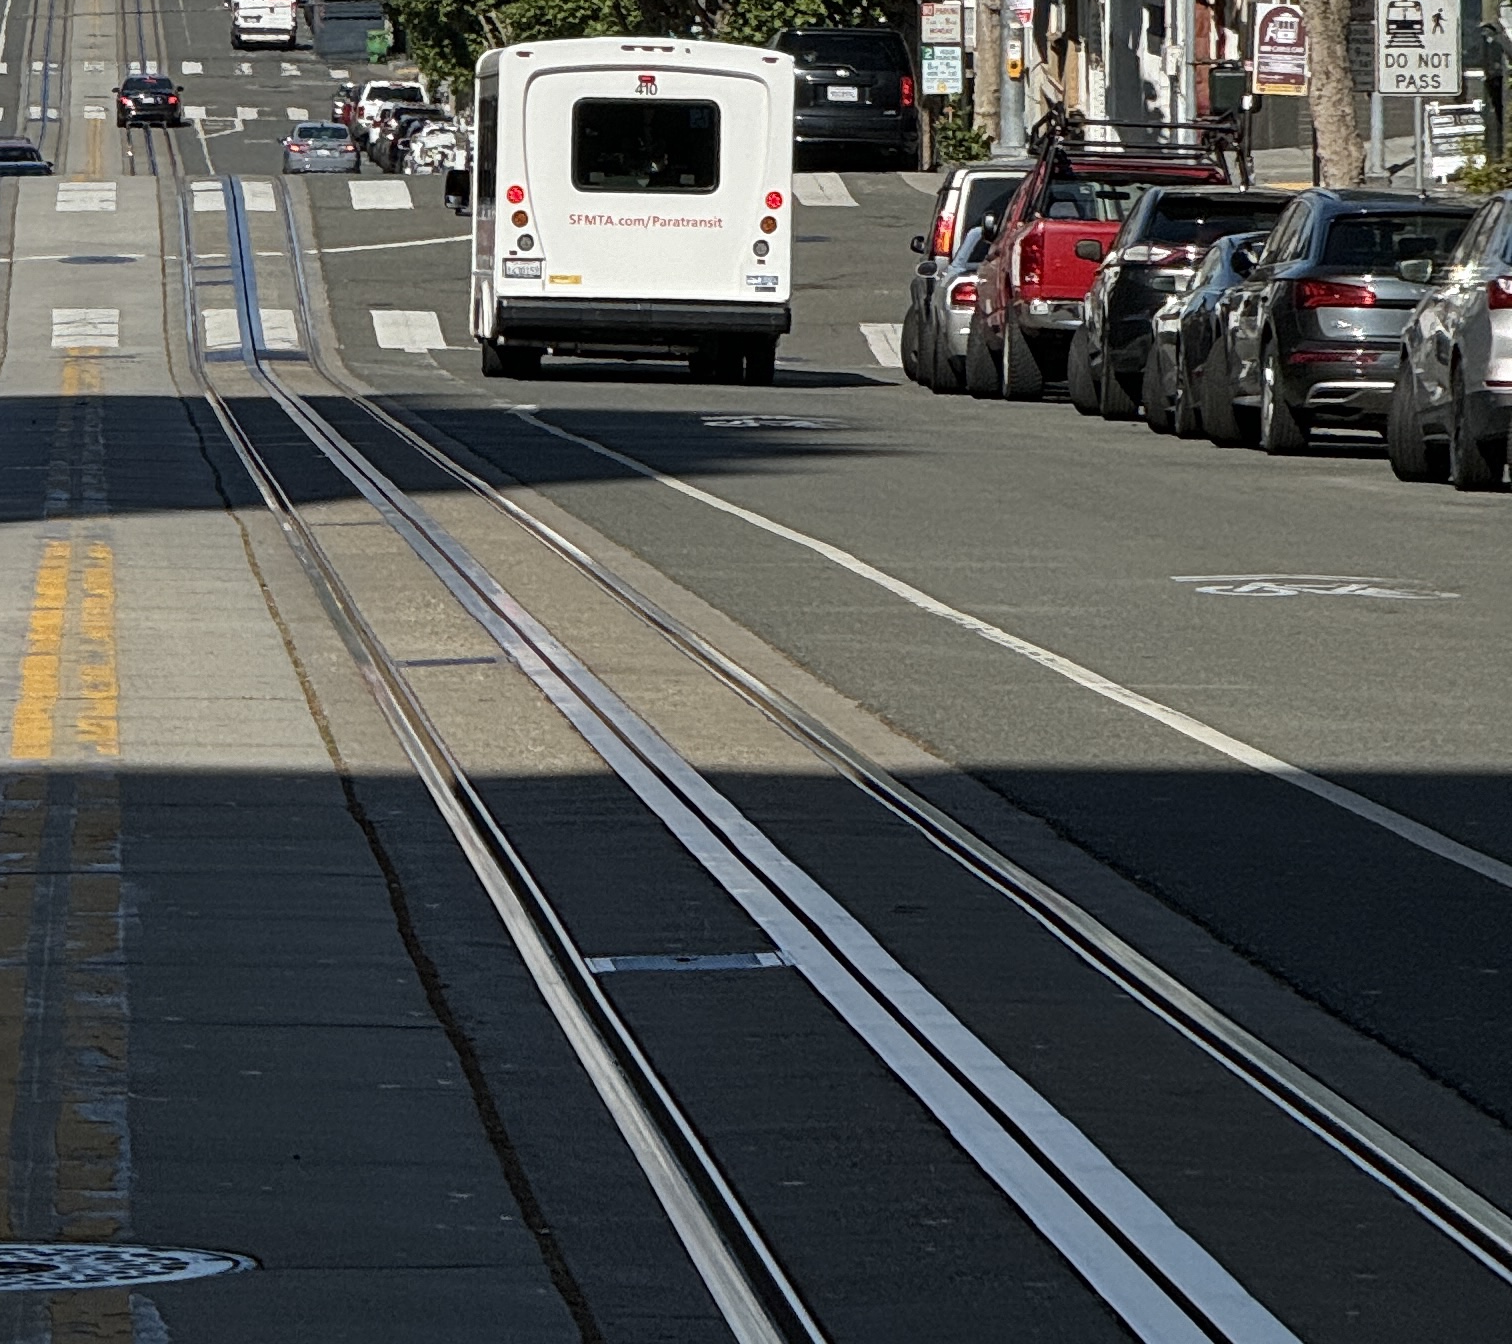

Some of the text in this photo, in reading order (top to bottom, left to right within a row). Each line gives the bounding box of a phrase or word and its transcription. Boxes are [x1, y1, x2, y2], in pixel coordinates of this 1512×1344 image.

[1385, 53, 1452, 68] DO NOT
[1395, 74, 1441, 89] PASS
[634, 83, 658, 96] 410
[568, 213, 724, 229] SFMTA.com/Paratransit
